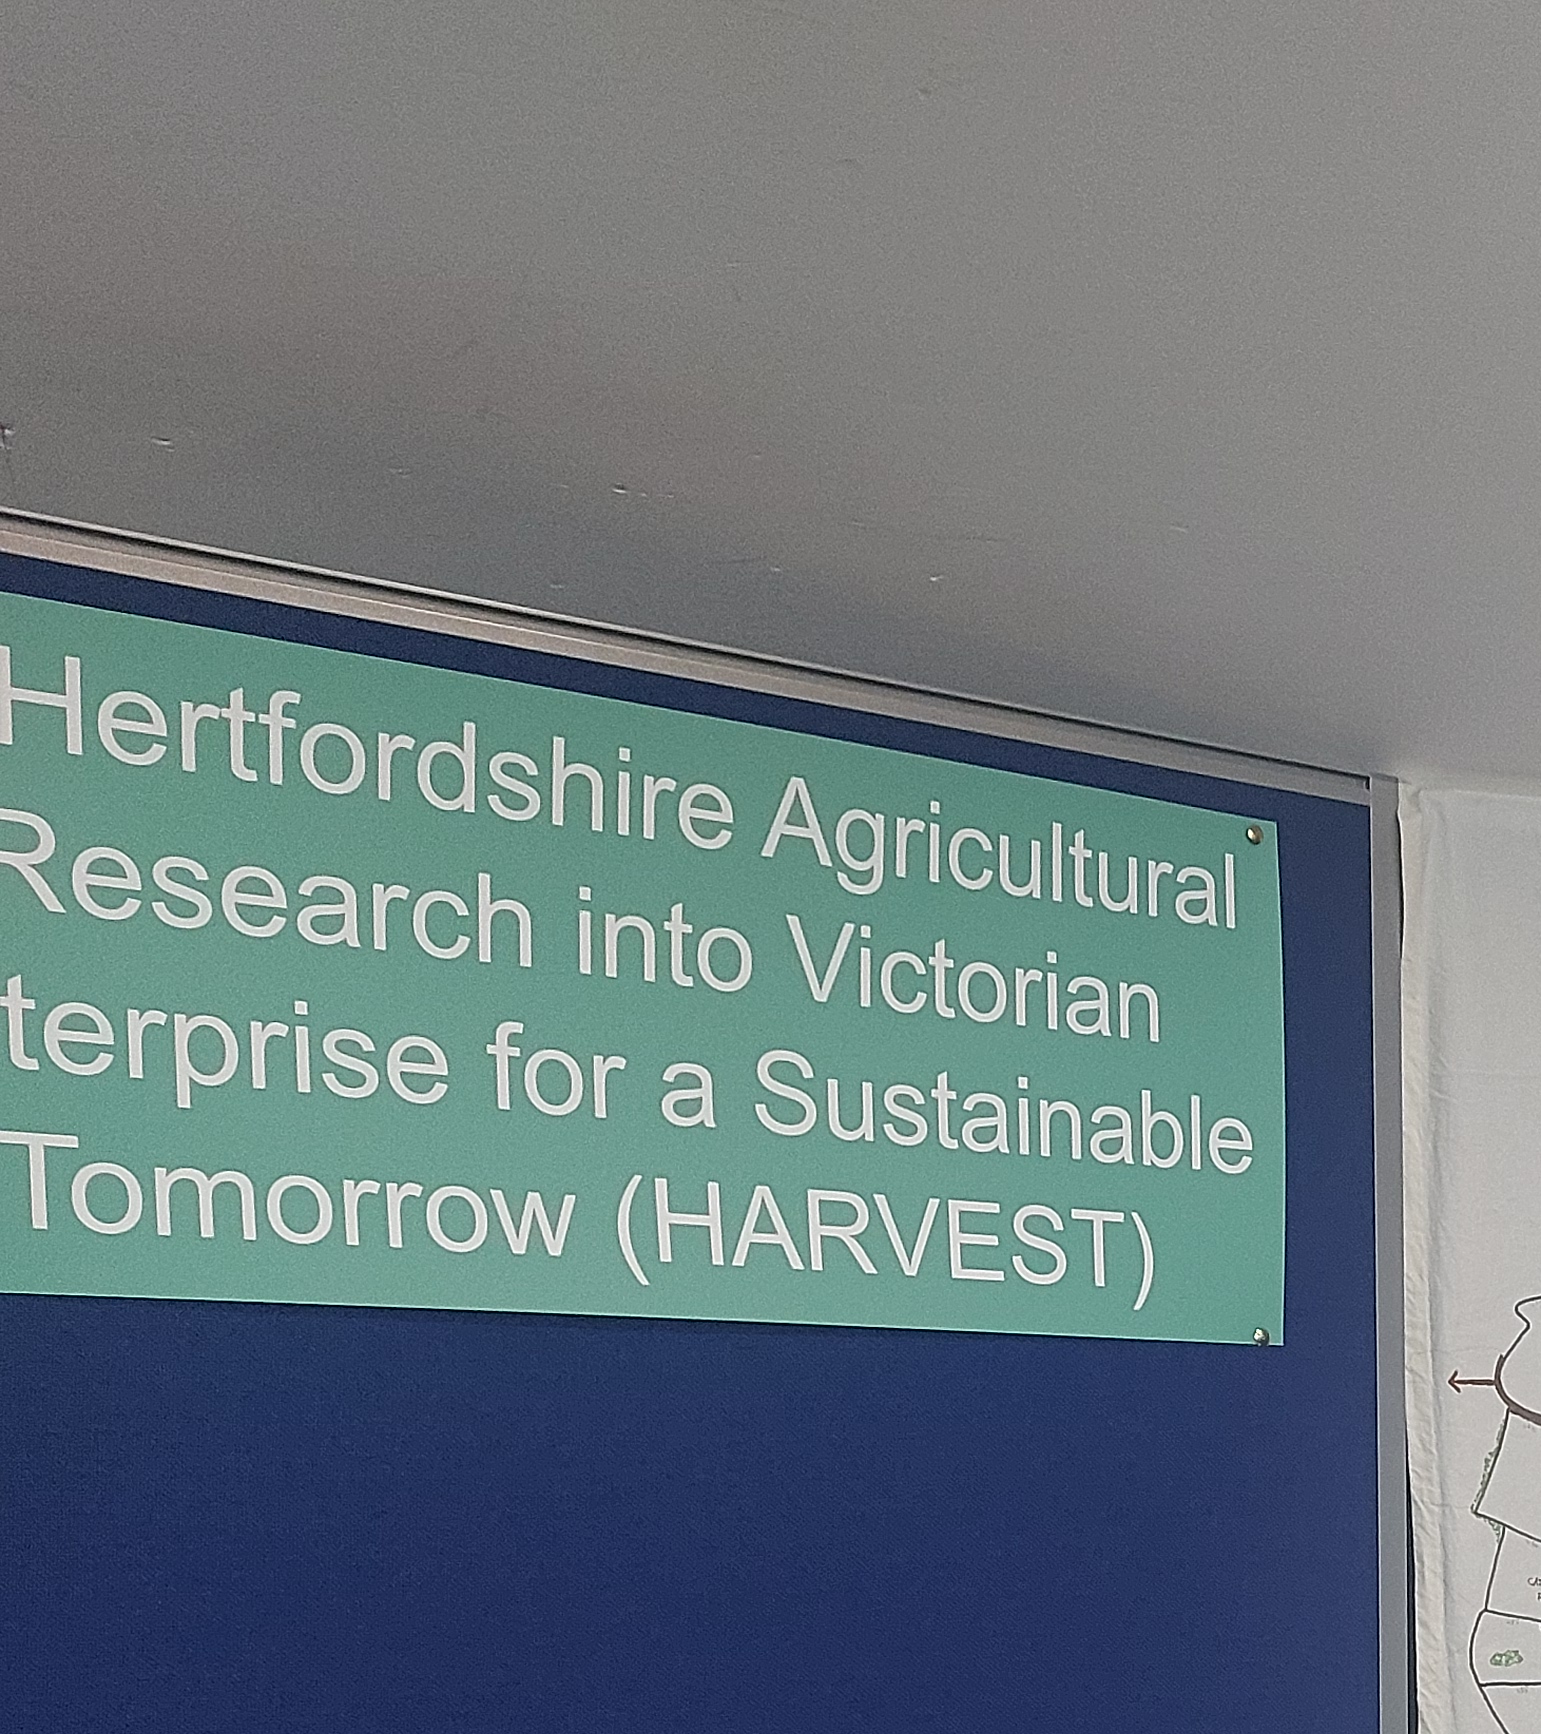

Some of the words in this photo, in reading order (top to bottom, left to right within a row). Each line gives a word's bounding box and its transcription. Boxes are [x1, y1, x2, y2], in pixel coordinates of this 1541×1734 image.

[0, 645, 733, 849] Hertfordshire
[761, 777, 1235, 929] Agricultural
[0, 808, 531, 967] Research
[579, 887, 752, 991] into
[786, 915, 1159, 1042] Victorian
[487, 1022, 626, 1118] for
[662, 1063, 716, 1127] a
[756, 1050, 1255, 1175] Sustainable
[0, 1131, 575, 1256] Tomorrow
[618, 1175, 1153, 1311] (HARVEST)
